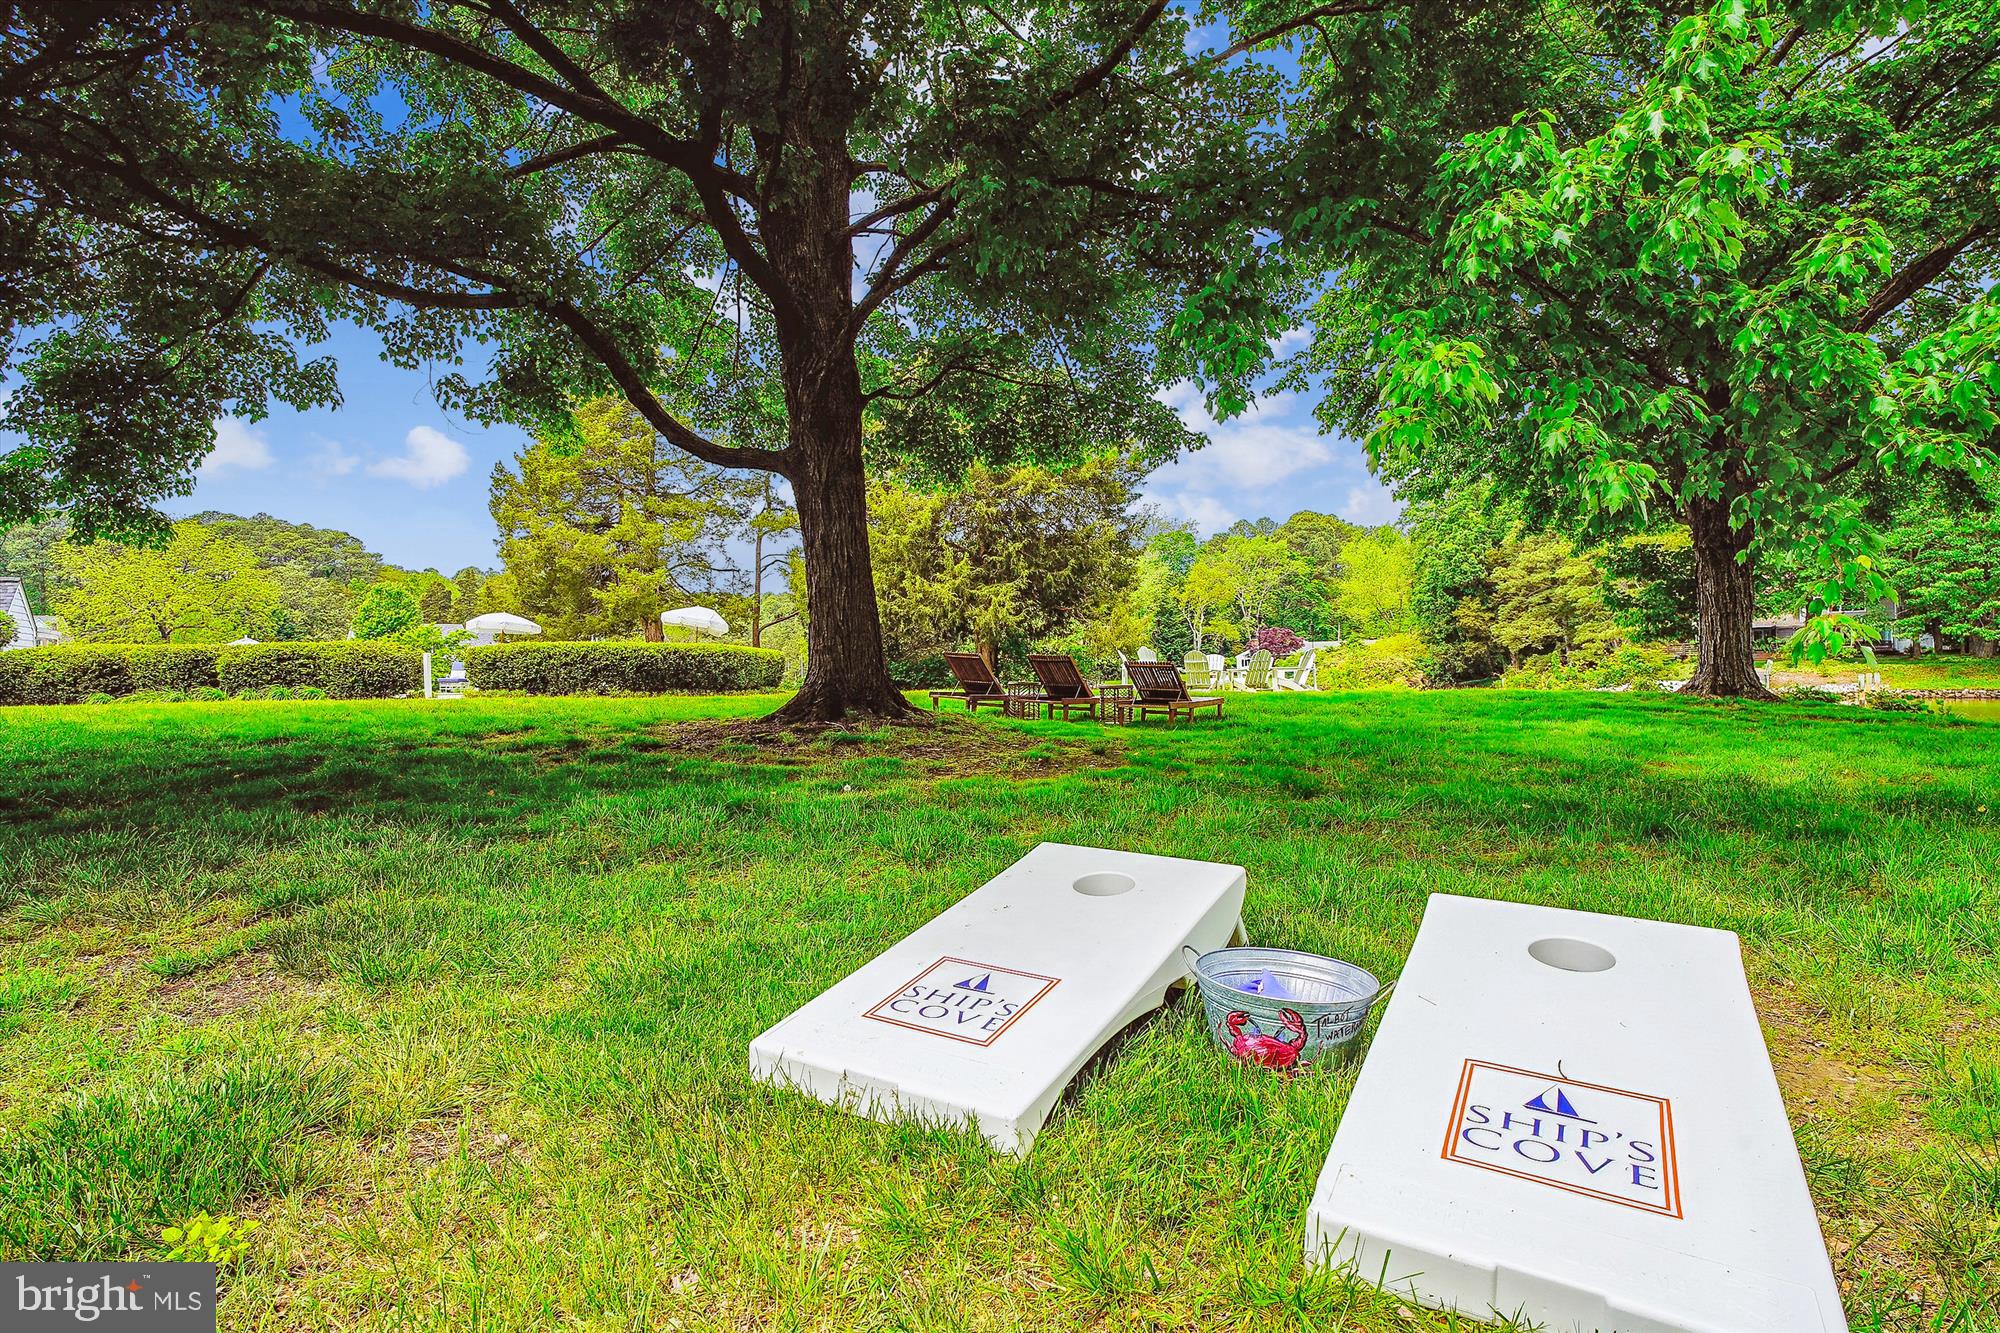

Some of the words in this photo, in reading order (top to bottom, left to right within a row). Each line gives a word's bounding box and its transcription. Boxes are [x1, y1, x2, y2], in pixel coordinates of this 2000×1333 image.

[890, 999, 1005, 1032] COVE
[902, 985, 1019, 1017] SHIP'S
[1465, 1104, 1655, 1162] SHIP'S
[1462, 1127, 1658, 1190] COVE
